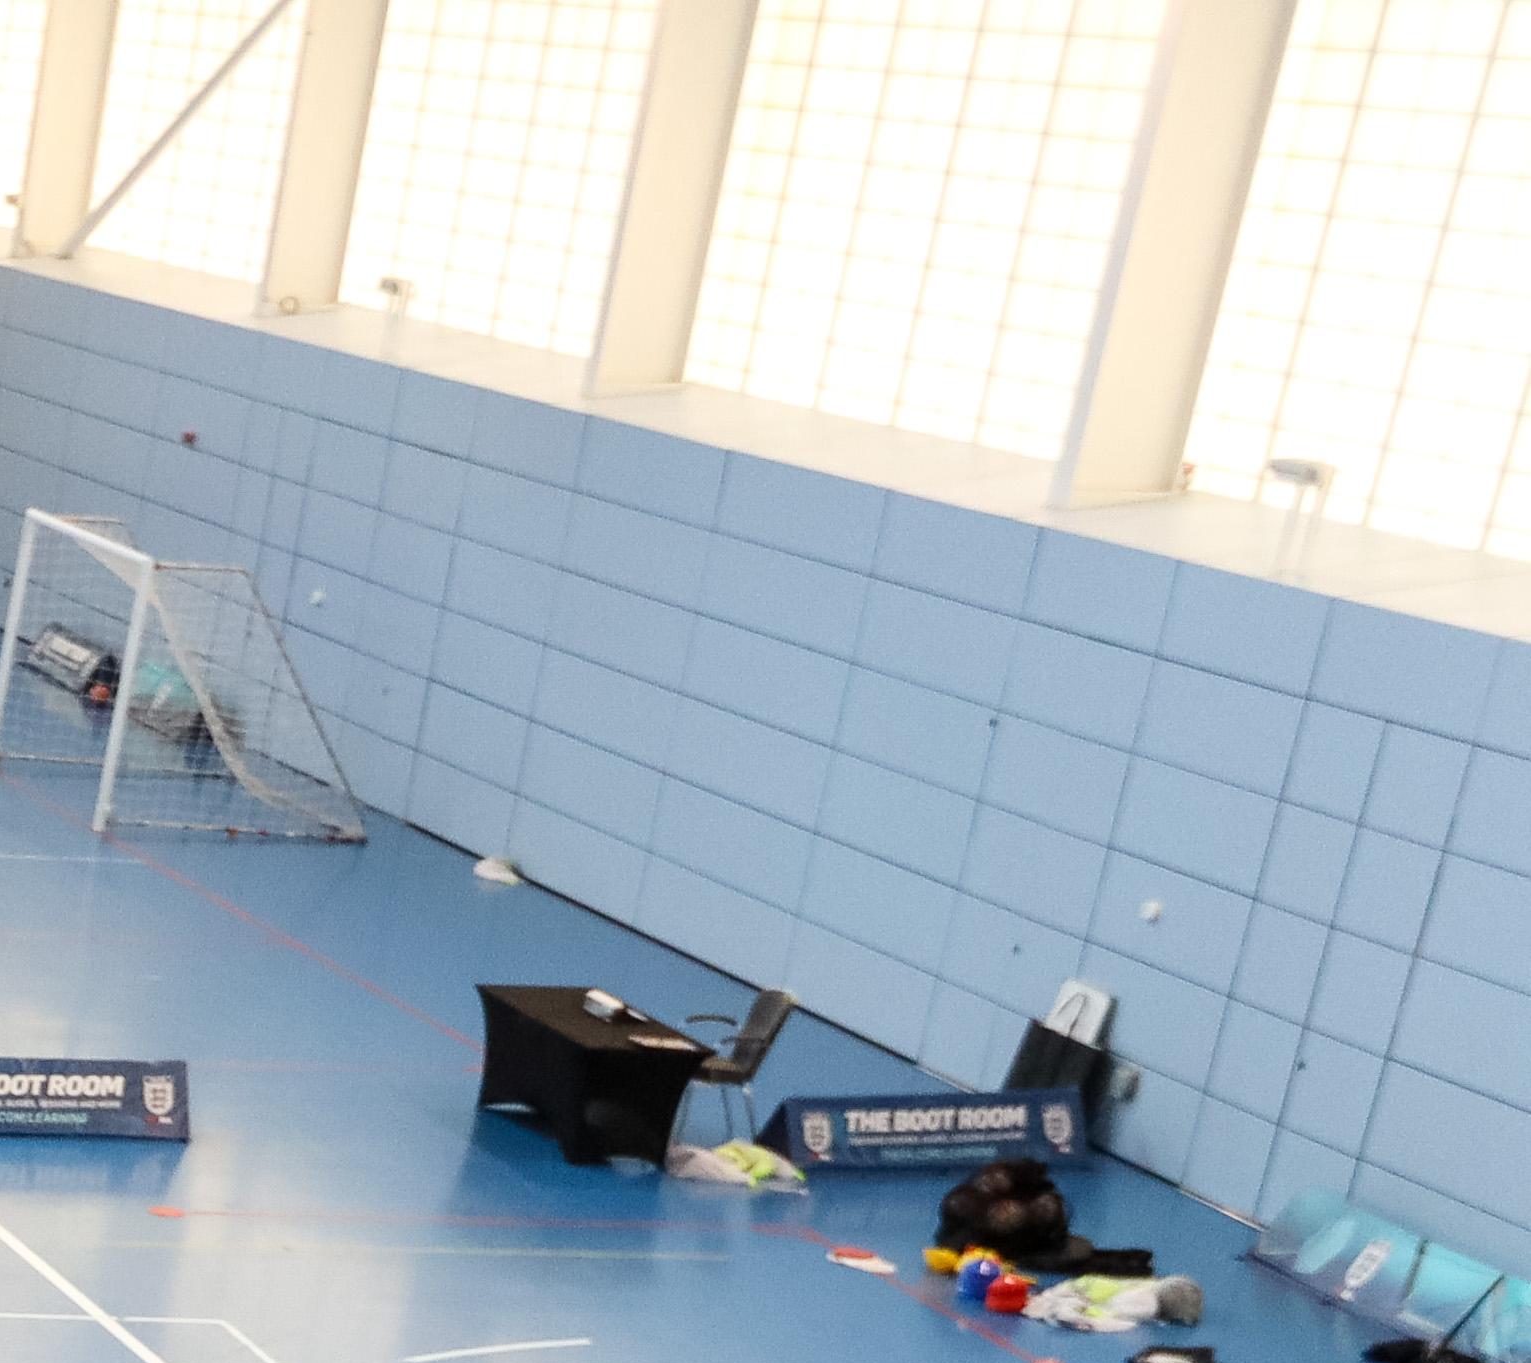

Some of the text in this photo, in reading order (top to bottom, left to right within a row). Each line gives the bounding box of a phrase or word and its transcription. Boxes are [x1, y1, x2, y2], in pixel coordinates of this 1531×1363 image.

[46, 1075, 126, 1098] ROOM
[844, 1104, 1028, 1133] THE BOOT ROOM
